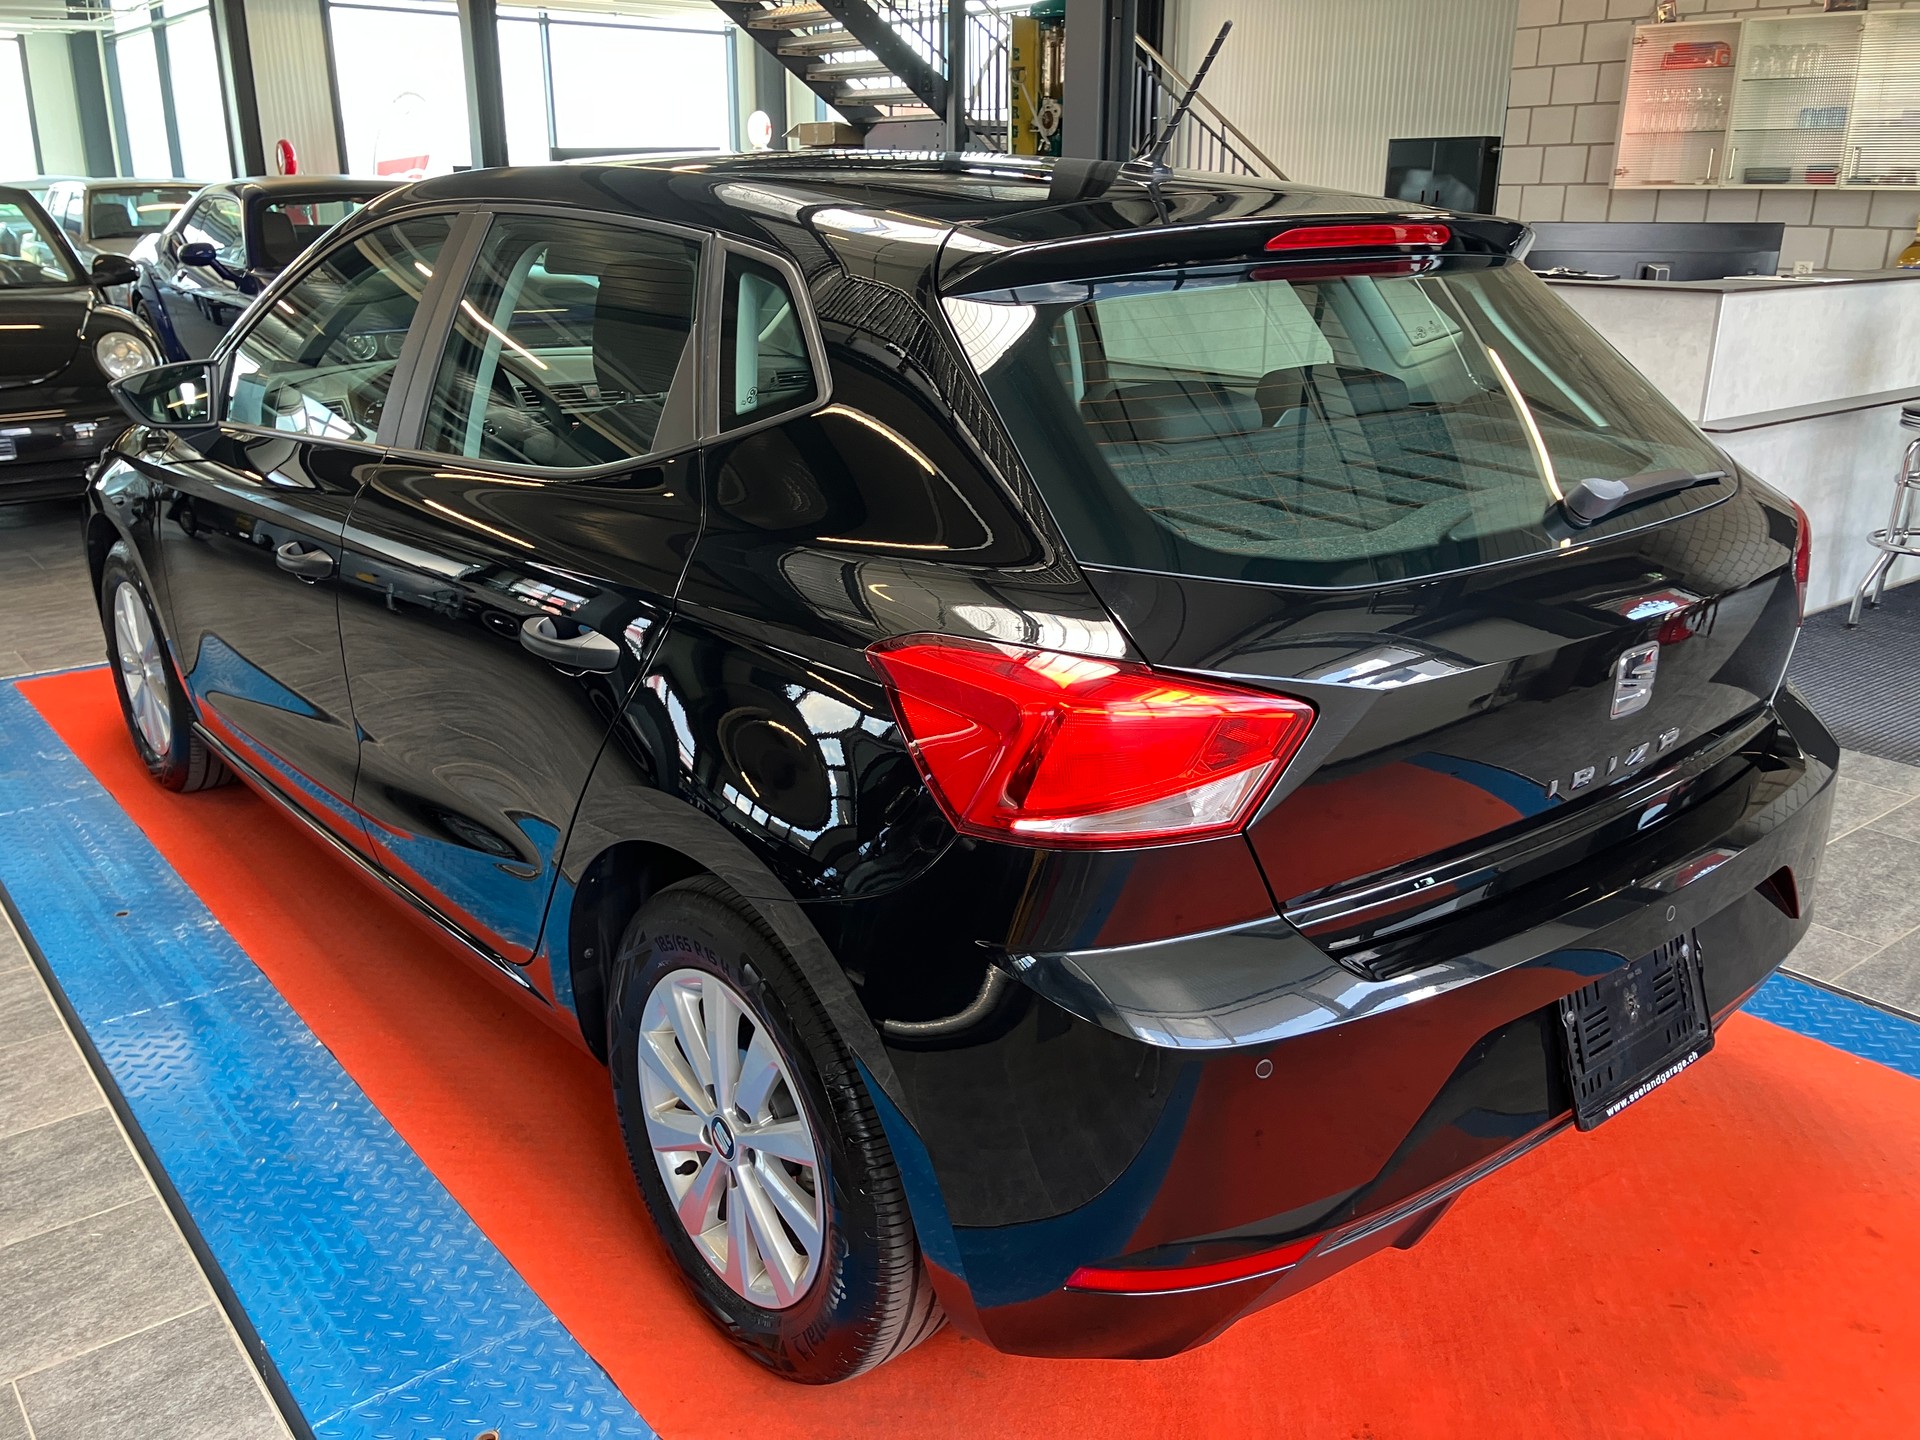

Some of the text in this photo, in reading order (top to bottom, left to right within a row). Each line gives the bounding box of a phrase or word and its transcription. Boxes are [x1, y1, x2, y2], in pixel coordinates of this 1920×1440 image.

[1545, 726, 1680, 800] IBIZA
[654, 933, 693, 954] 185/65
[693, 938, 704, 959] R
[1606, 1051, 1698, 1117] www.seelandgarage.ch
